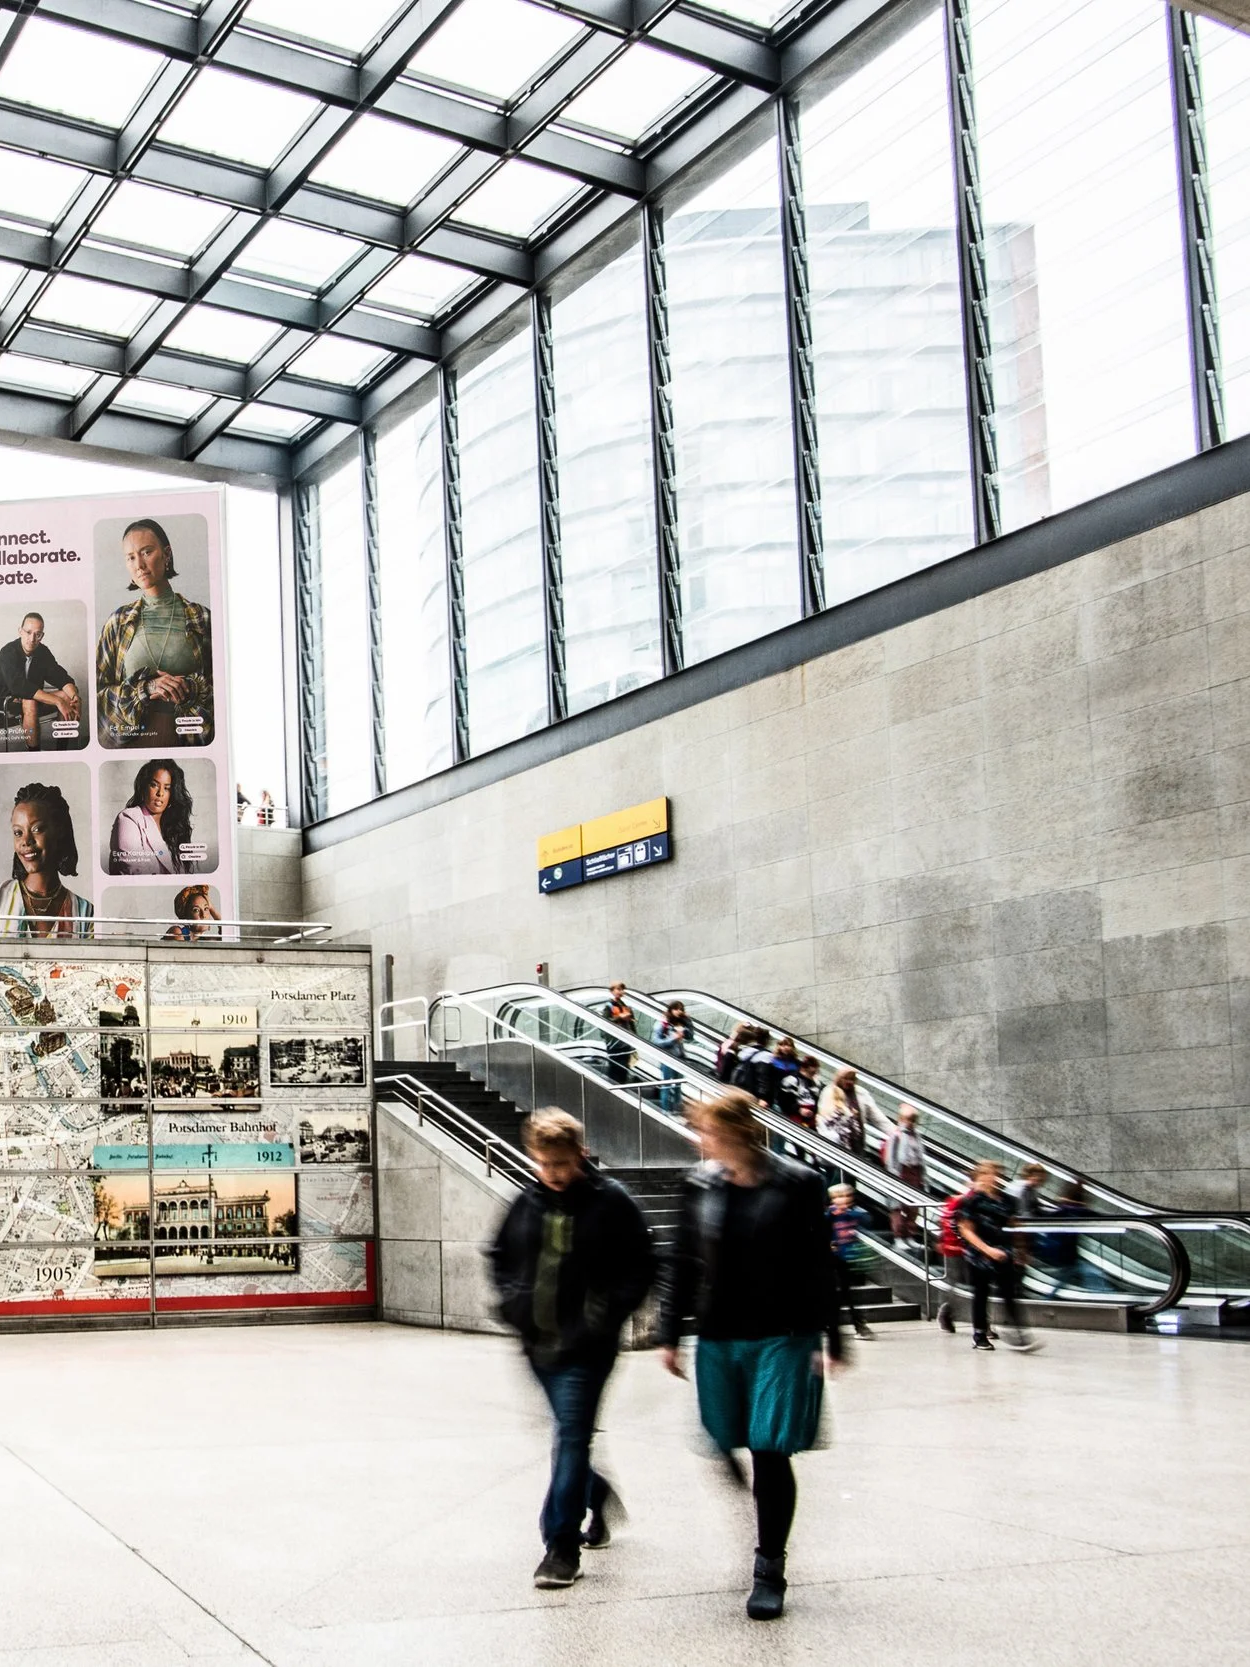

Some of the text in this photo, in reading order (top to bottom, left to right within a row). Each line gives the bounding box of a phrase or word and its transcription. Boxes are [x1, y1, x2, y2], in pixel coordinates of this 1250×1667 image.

[271, 990, 356, 1001] Potsdamer Platz
[222, 1014, 248, 1025] 1910
[168, 1122, 278, 1133] Potsdamer Bahnhof
[256, 1150, 283, 1163] 1912
[35, 1266, 73, 1282] 1905
